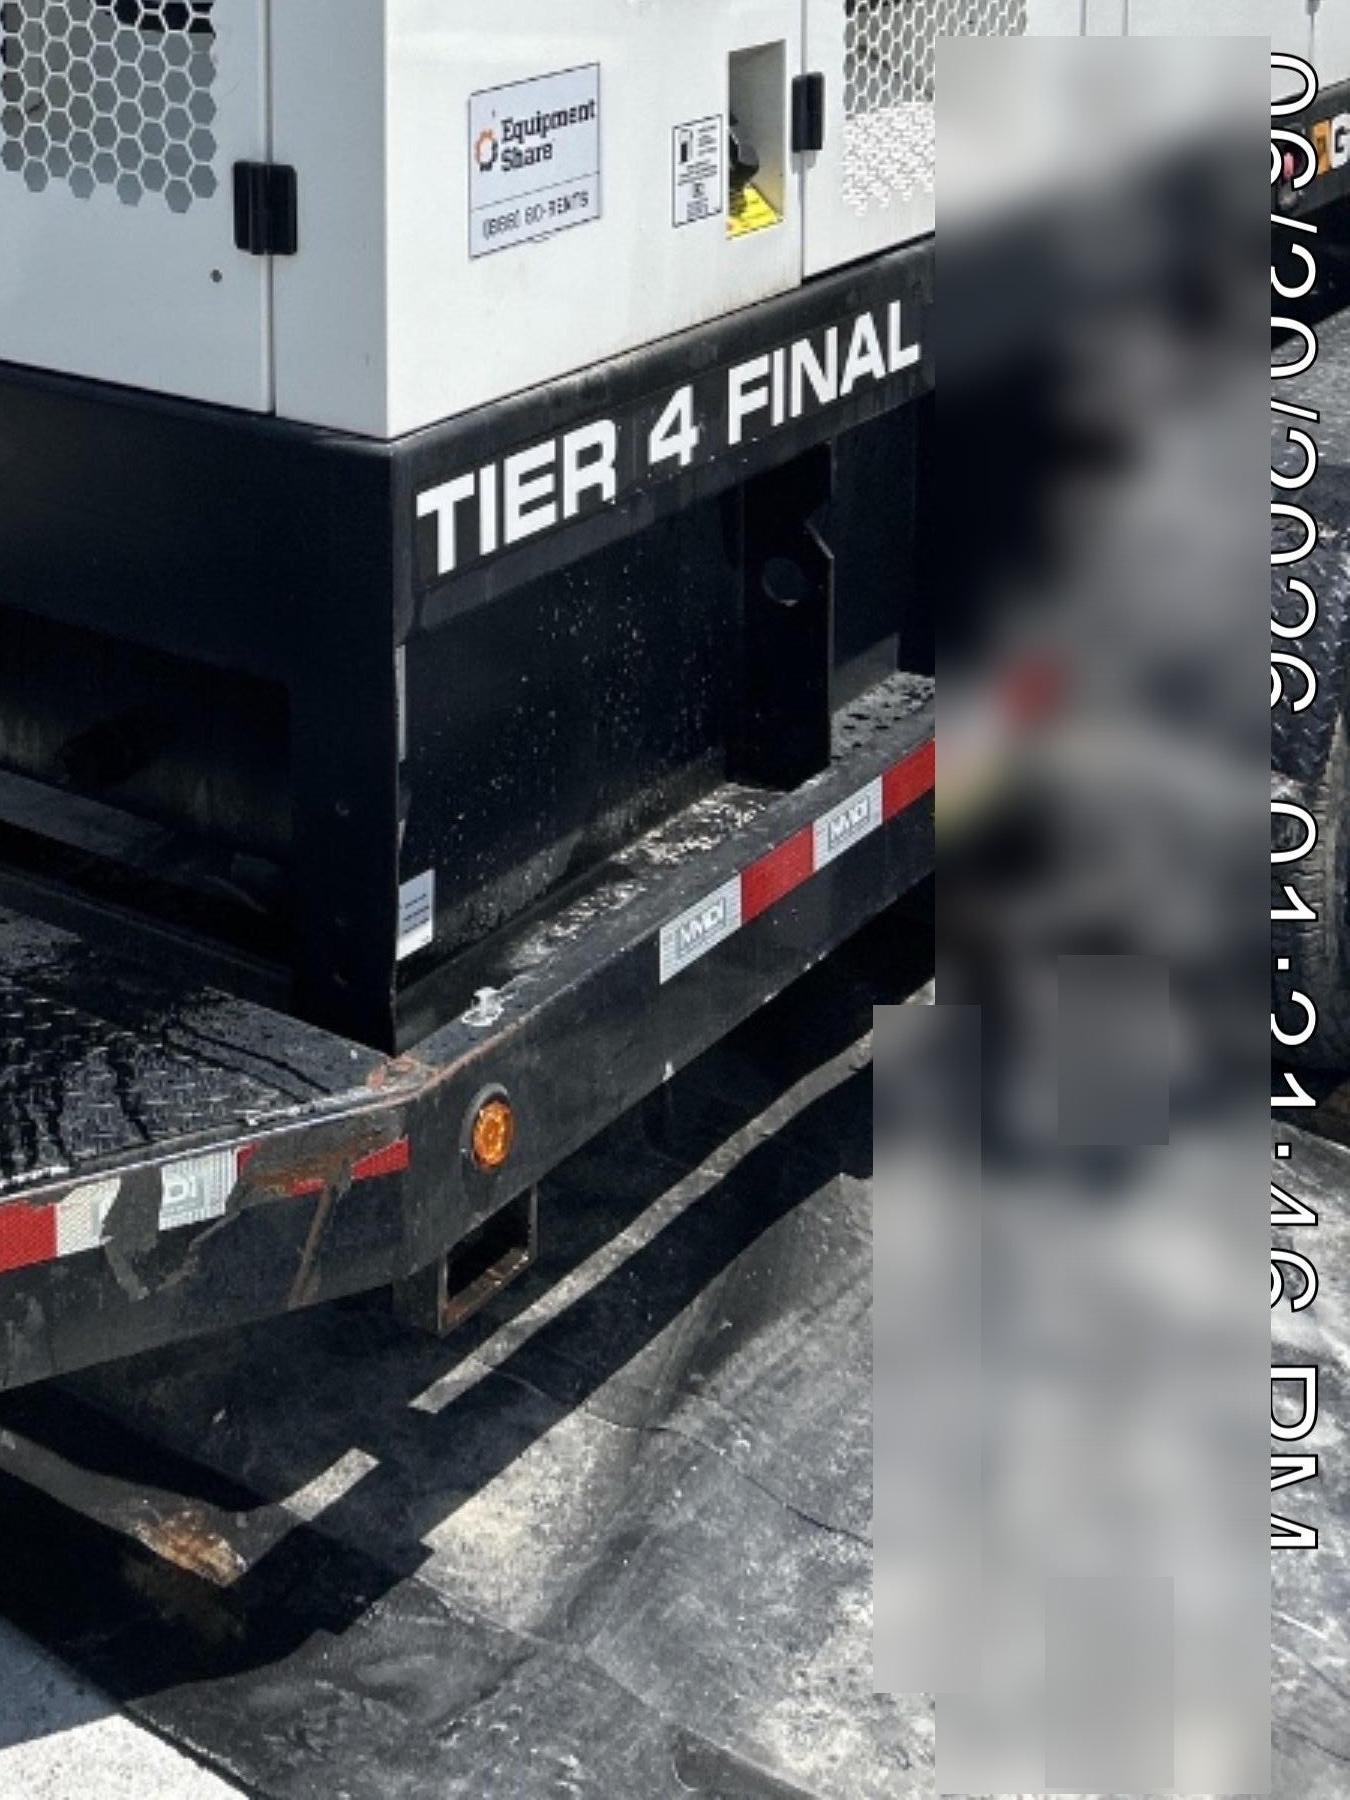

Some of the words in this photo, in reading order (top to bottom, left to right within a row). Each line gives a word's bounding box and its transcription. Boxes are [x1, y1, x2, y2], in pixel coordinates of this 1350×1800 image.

[500, 98, 596, 146] Equipment
[500, 142, 554, 173] Share
[415, 418, 618, 576] TIER
[648, 386, 699, 466] 4
[727, 299, 921, 444] FINAL
